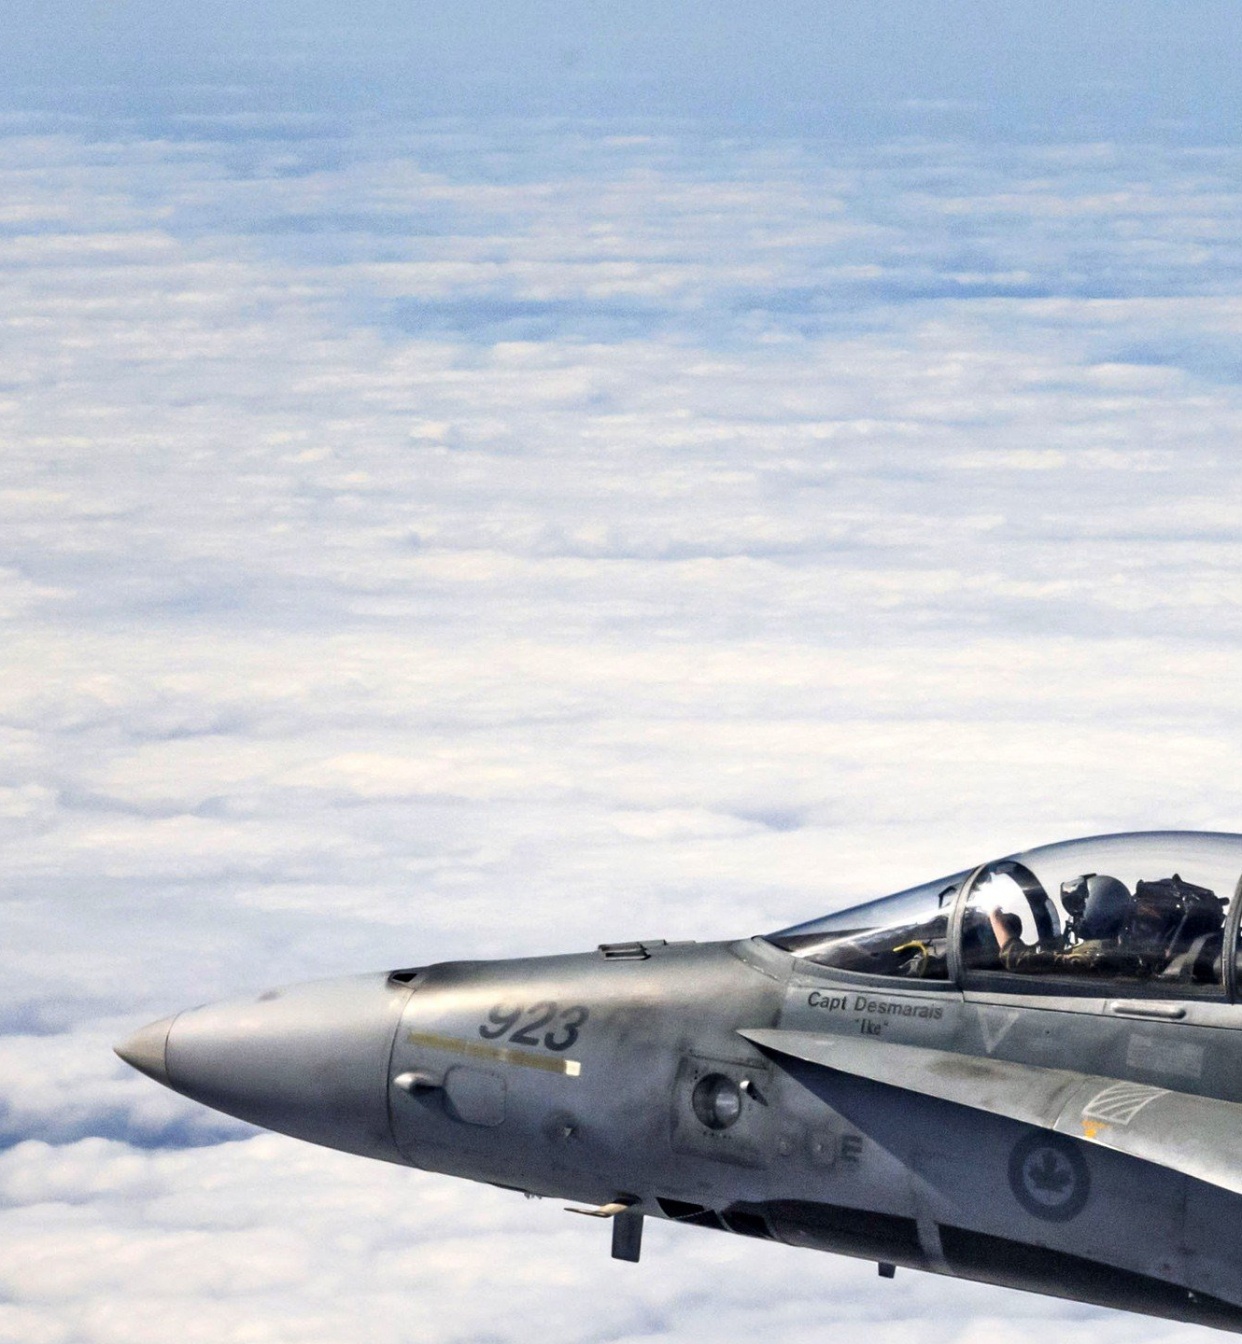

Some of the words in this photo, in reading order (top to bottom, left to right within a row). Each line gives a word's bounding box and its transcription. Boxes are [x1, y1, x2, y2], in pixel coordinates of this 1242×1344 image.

[807, 991, 847, 1012] Capt
[854, 996, 944, 1020] Desmarais
[479, 1001, 590, 1052] 923
